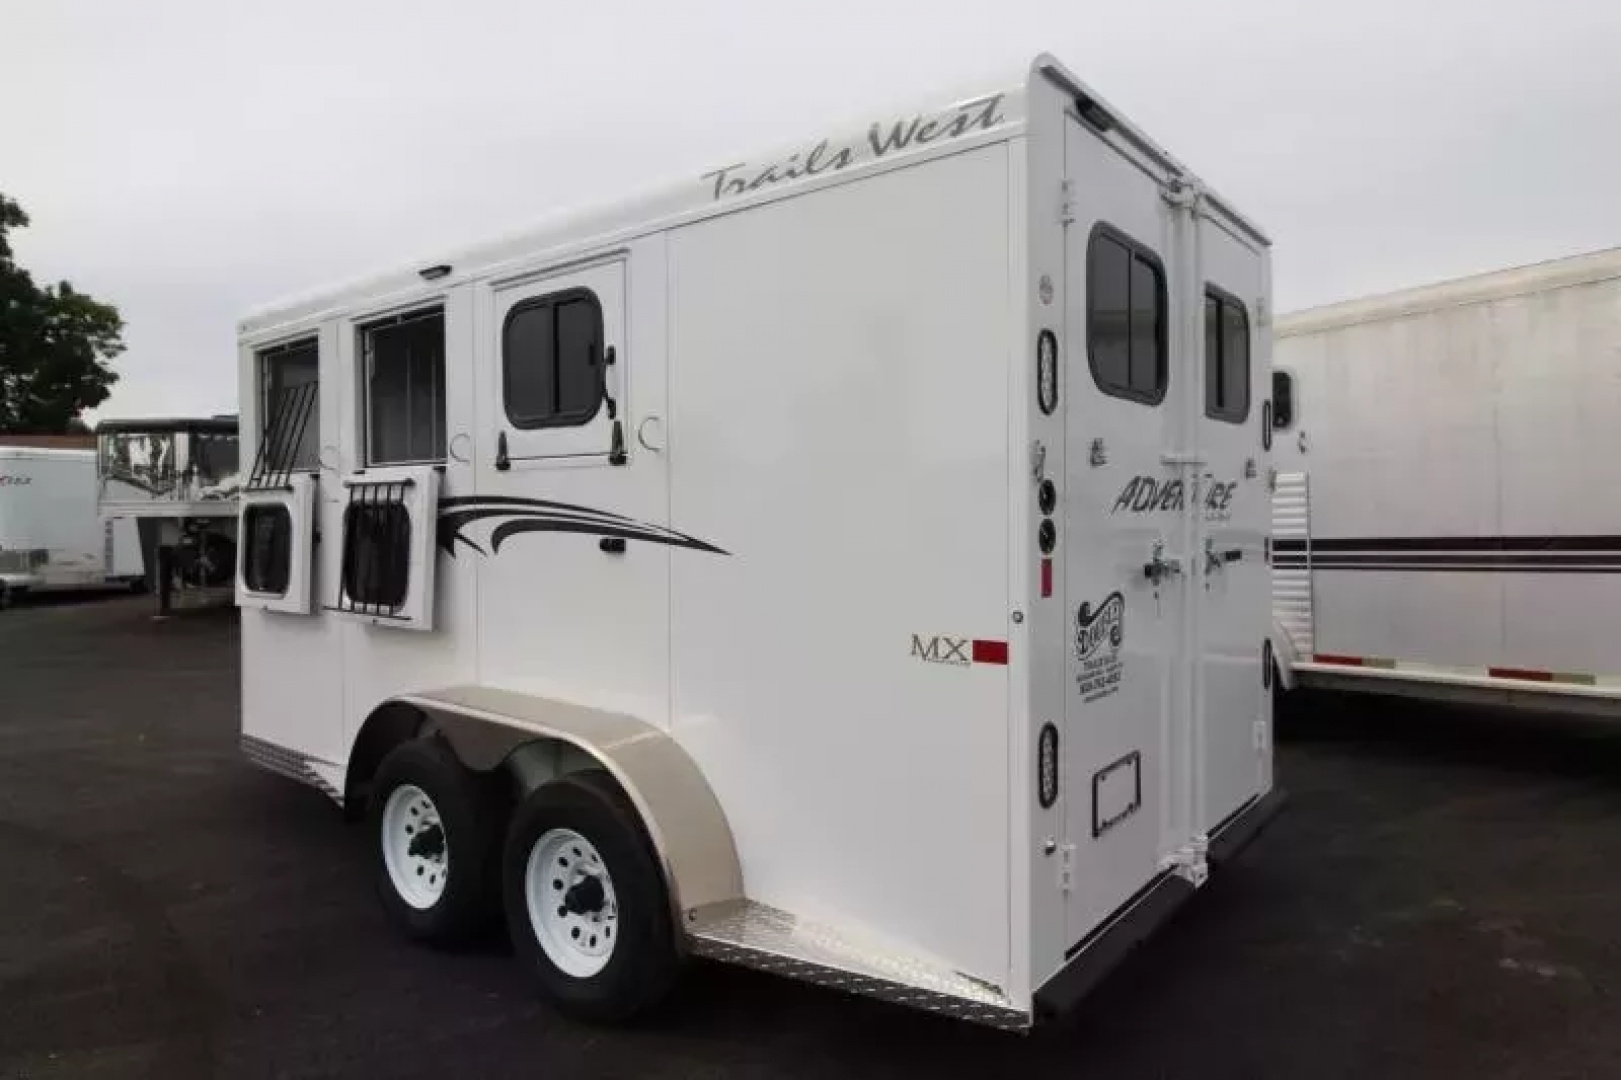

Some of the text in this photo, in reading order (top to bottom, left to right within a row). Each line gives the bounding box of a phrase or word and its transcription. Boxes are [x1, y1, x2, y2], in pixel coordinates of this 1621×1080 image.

[701, 94, 1005, 200] Trails West
[911, 633, 968, 661] MX
